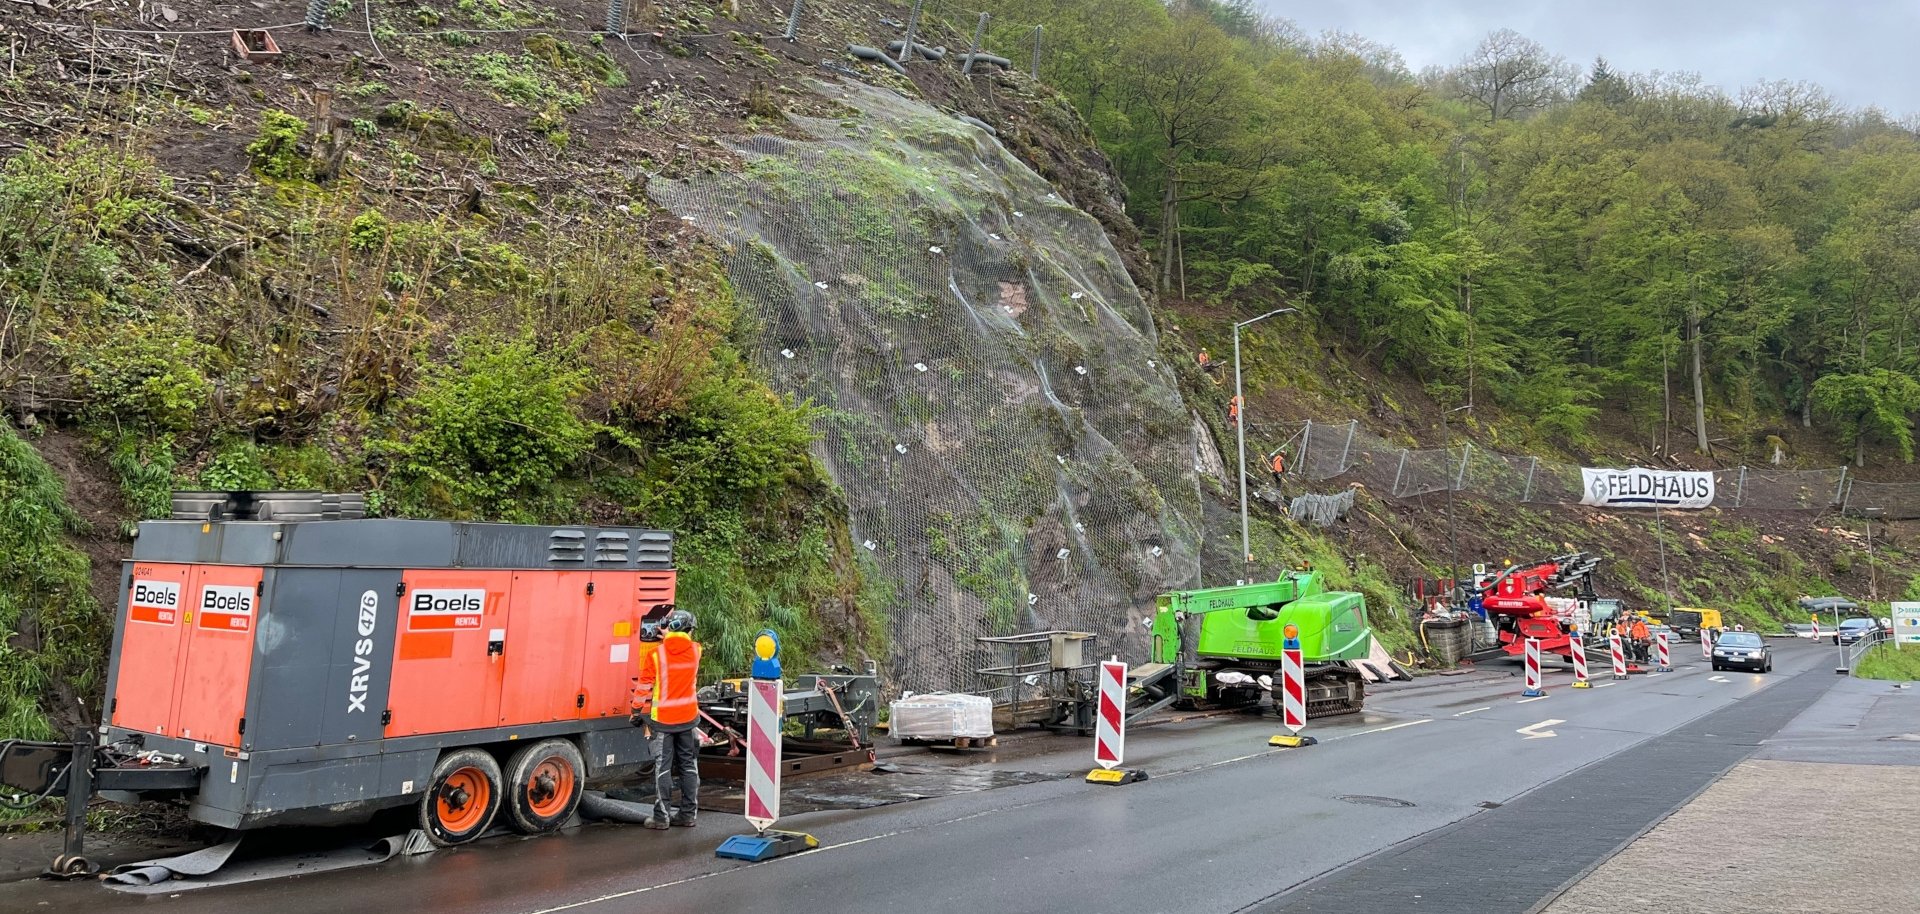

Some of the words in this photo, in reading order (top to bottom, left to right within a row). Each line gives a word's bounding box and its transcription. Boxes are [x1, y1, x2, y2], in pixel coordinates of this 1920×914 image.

[1607, 474, 1709, 498] FELDHAUS
[135, 585, 176, 605] Boels
[204, 590, 250, 611] Boels
[414, 594, 480, 611] Boels
[1209, 597, 1235, 609] FELDHAUS
[360, 595, 376, 630] 476
[455, 616, 479, 627] RENTAL
[1232, 646, 1276, 655] FELDHAUS
[347, 638, 374, 714] XRVS
